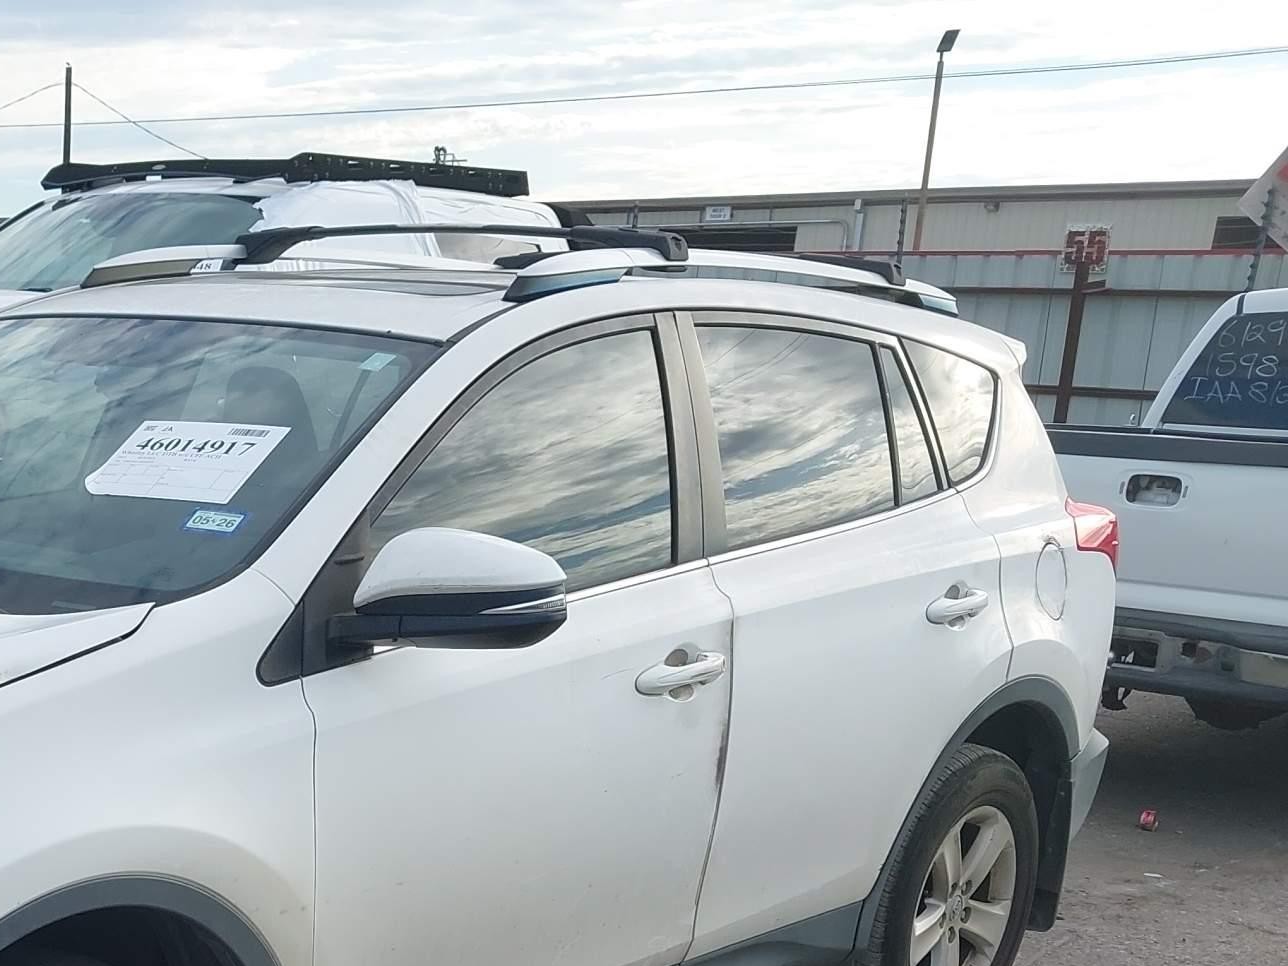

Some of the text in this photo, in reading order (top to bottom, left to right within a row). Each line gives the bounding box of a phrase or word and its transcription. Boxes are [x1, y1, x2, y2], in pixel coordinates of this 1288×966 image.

[1064, 231, 1108, 266] 55
[1206, 352, 1279, 379] 1598
[1183, 376, 1242, 404] IAA
[136, 437, 257, 456] 46014917
[192, 515, 212, 525] 05
[215, 518, 237, 528] 26
